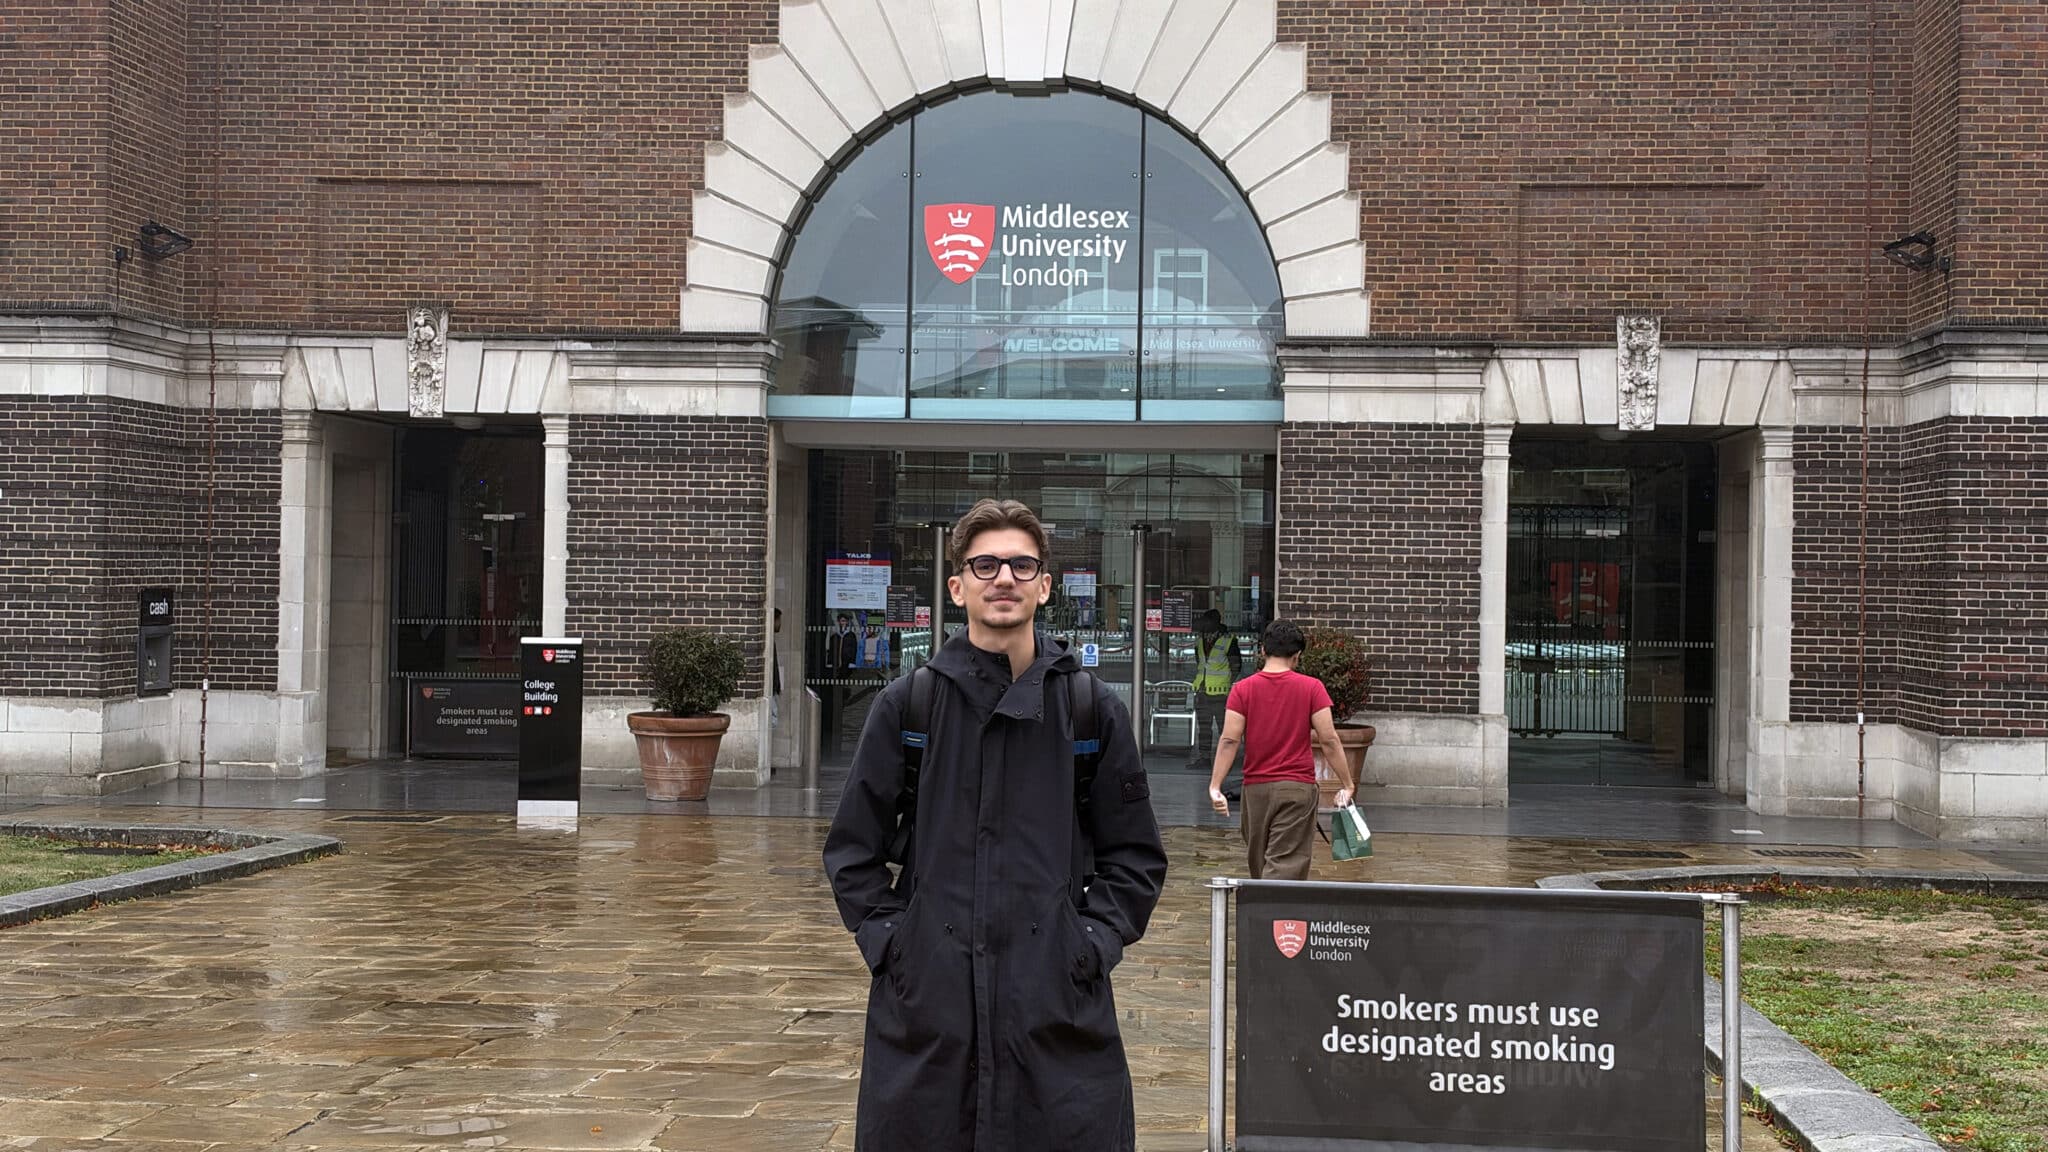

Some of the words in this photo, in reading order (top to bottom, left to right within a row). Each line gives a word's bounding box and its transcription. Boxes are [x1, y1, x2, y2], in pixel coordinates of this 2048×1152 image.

[1002, 203, 1130, 229] Middlesex
[1002, 234, 1127, 263] University
[1002, 262, 1088, 286] London
[1208, 337, 1262, 350] University
[149, 598, 169, 615] cash
[524, 680, 555, 691] College
[524, 692, 558, 704] Building
[440, 707, 475, 716] Smokers
[477, 708, 498, 716] must
[499, 709, 514, 717] use
[436, 716, 482, 727] designated
[483, 716, 518, 728] smoking
[465, 727, 488, 736] areas
[1309, 920, 1371, 936] Middlesex
[1309, 935, 1370, 951] University
[1309, 948, 1353, 962] London
[1337, 993, 1459, 1023] Smokers
[1468, 1001, 1540, 1026] must
[1550, 1006, 1600, 1028] use
[1321, 1025, 1481, 1062] designated
[1490, 1035, 1616, 1071] smoking
[1428, 1072, 1506, 1095] areas
